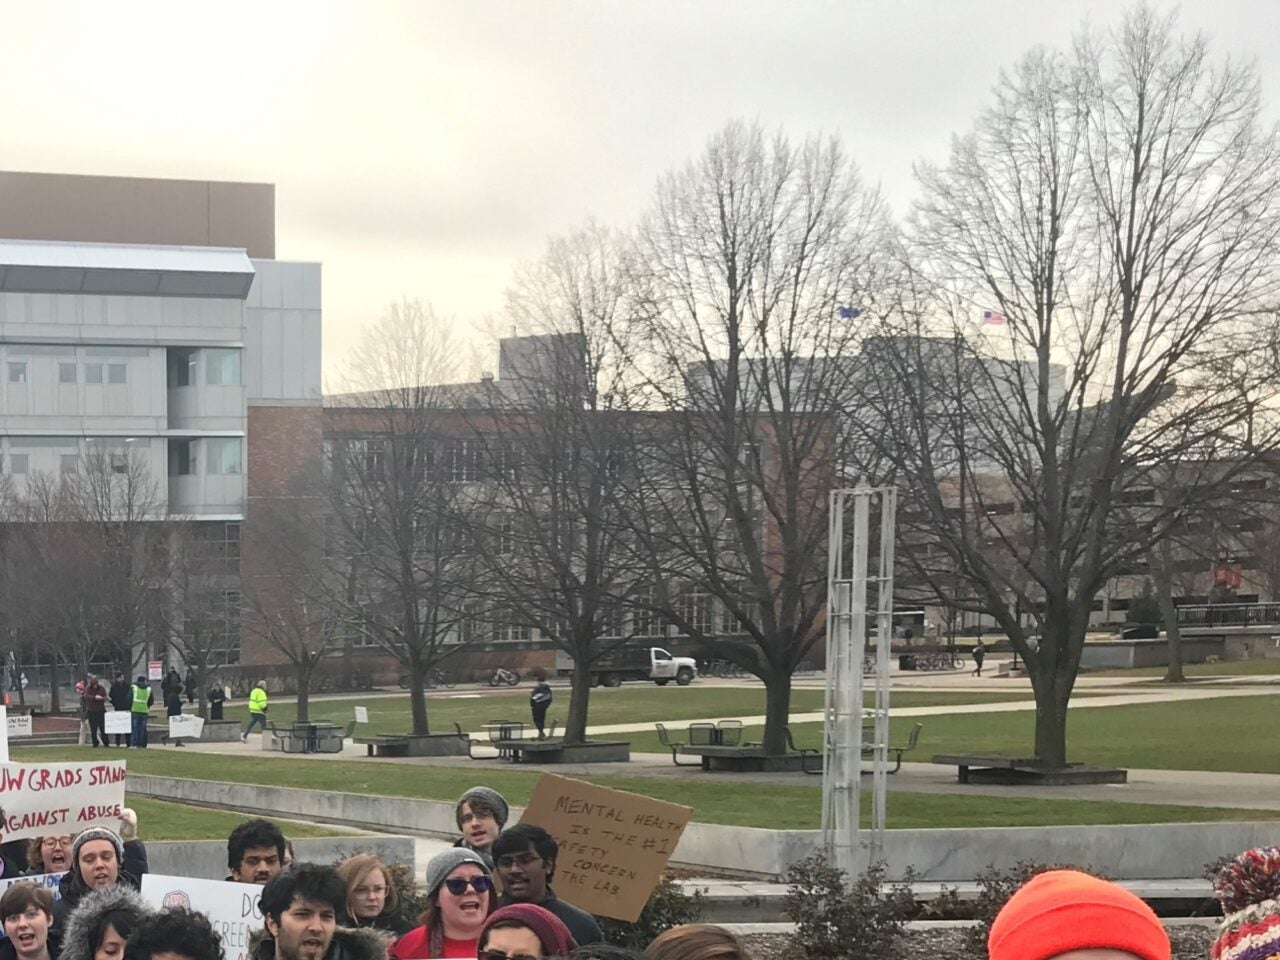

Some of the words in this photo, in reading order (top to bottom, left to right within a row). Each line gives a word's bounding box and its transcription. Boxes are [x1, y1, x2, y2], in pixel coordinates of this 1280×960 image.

[28, 768, 82, 791] GRADS
[89, 766, 126, 786] STAND
[77, 804, 121, 822] ABUSE
[554, 795, 624, 823] MENTAL
[634, 813, 682, 833] HEALTH
[554, 837, 608, 858] AFETY
[570, 824, 591, 835] IS
[601, 830, 637, 846] THE
[642, 838, 670, 855] #1
[572, 859, 637, 880] CONCERN
[561, 870, 589, 885] THE
[593, 878, 620, 895] LAB
